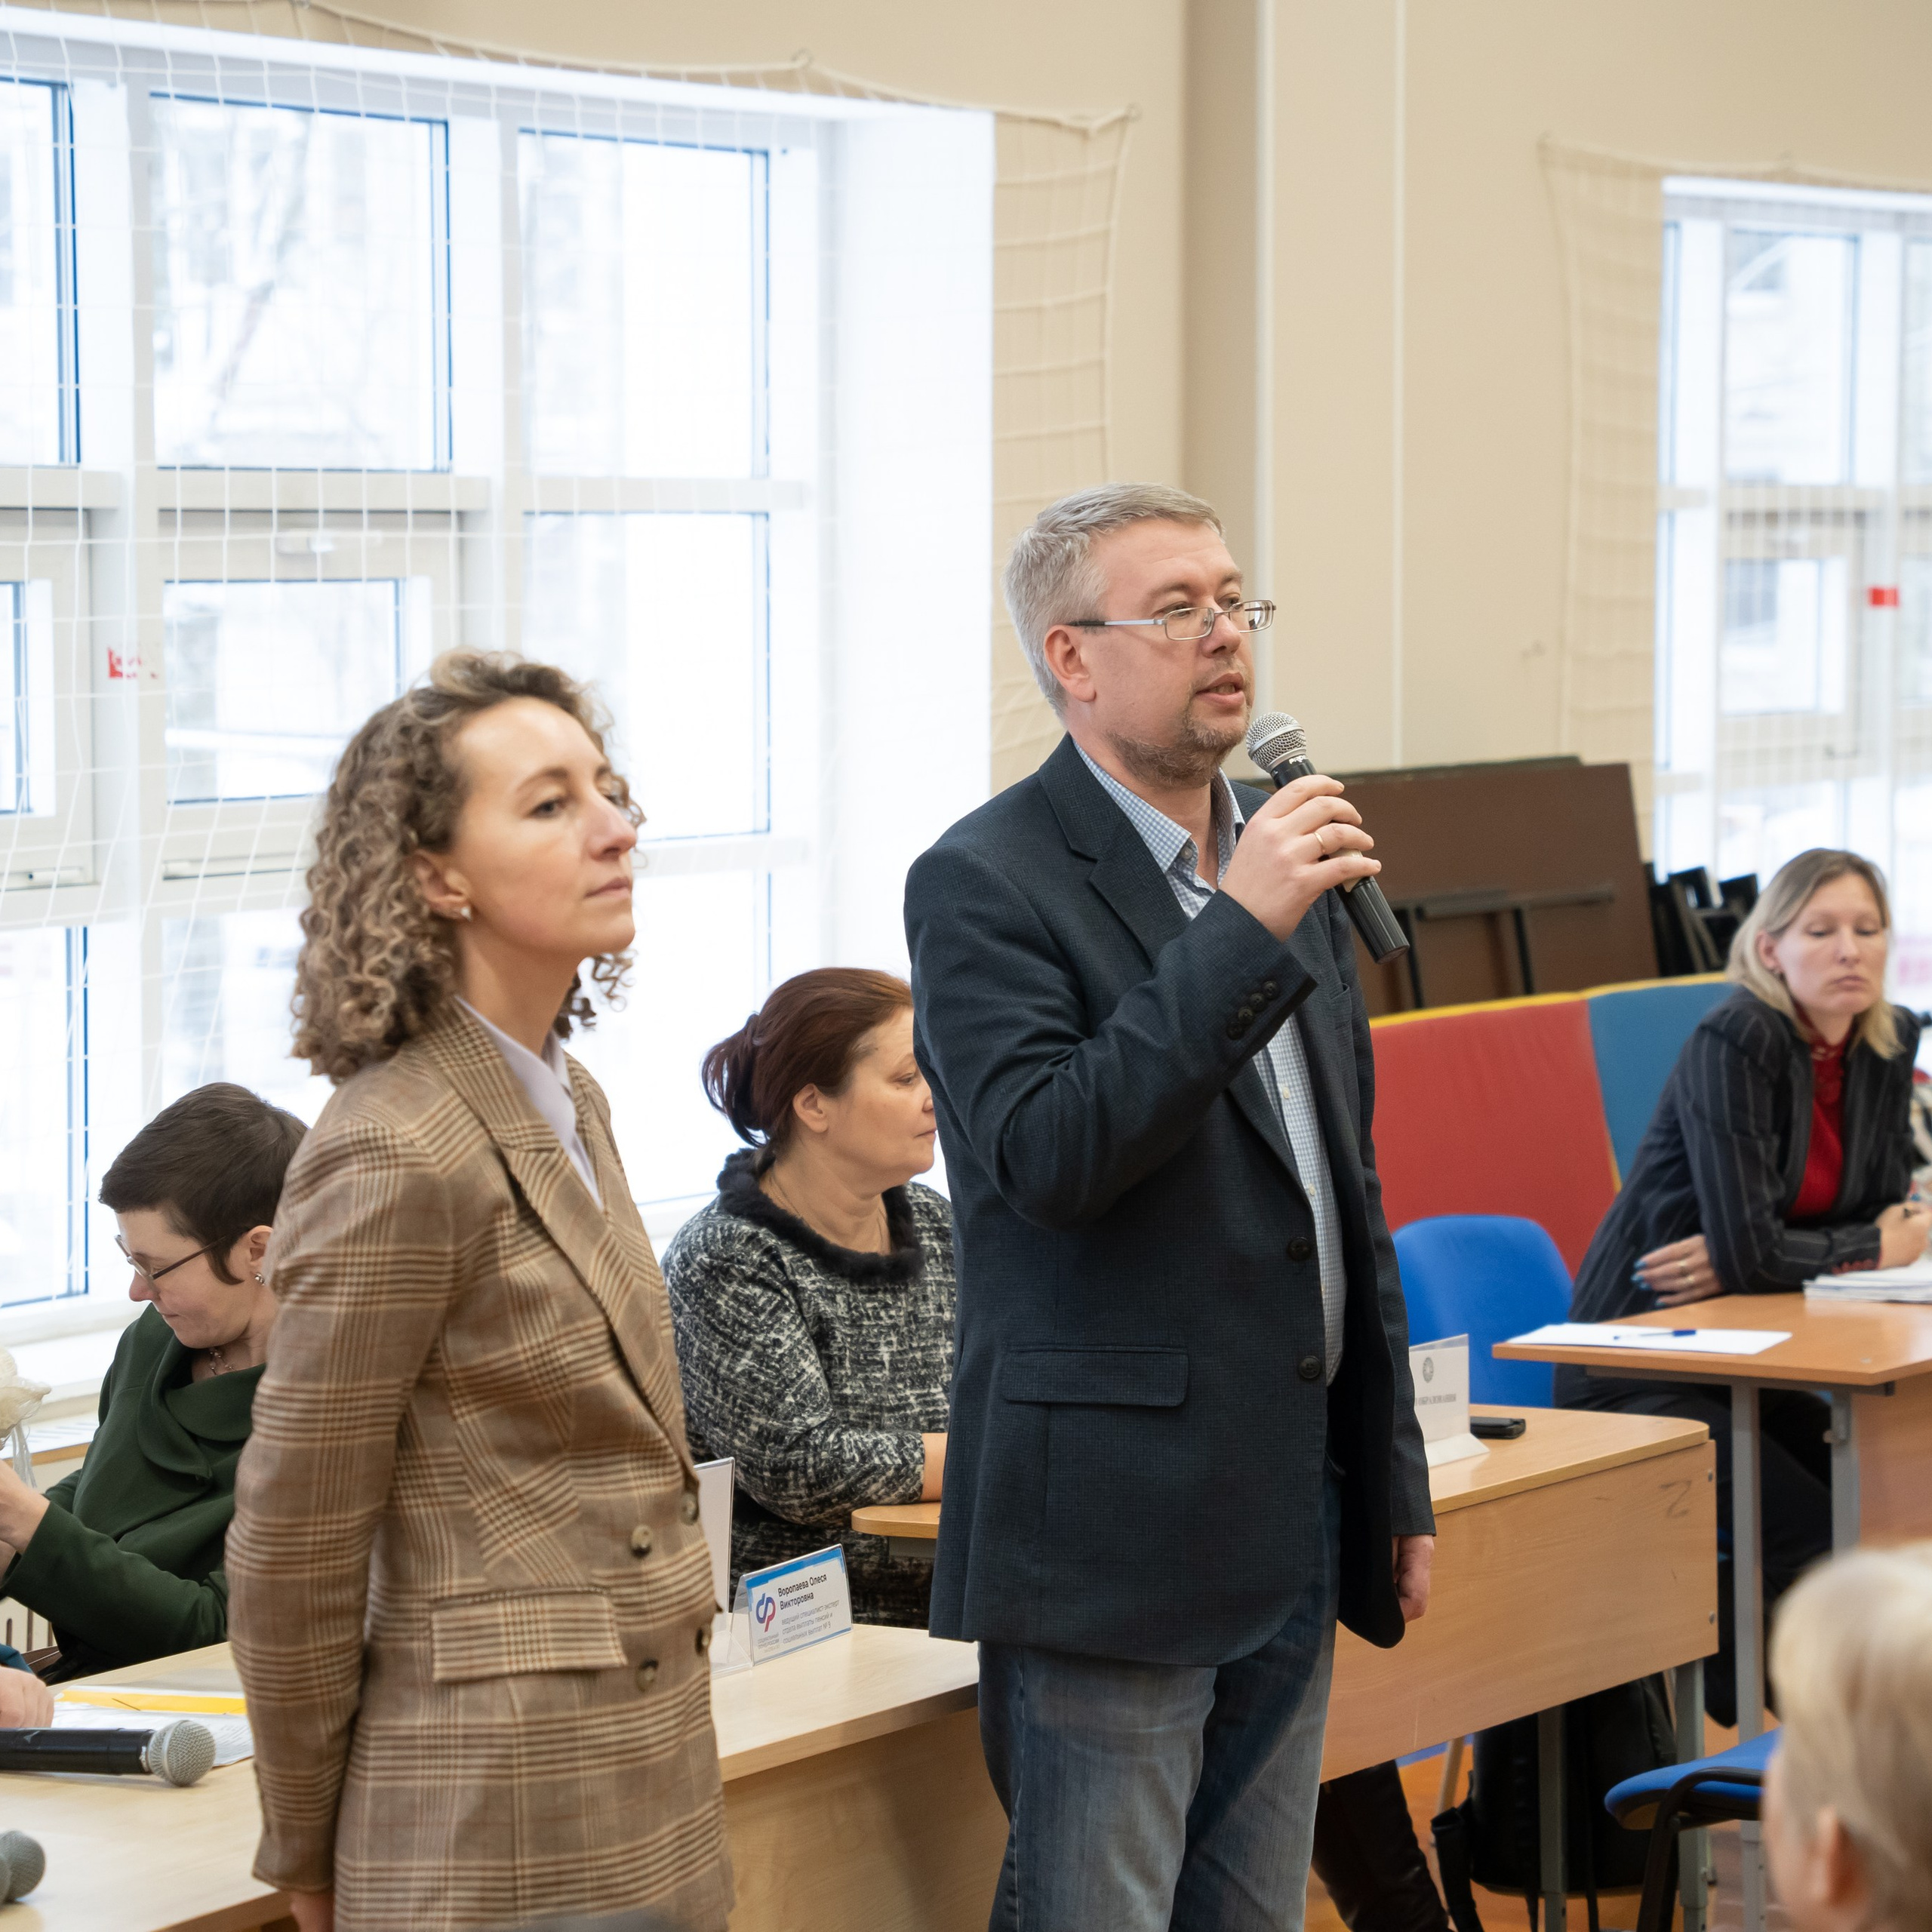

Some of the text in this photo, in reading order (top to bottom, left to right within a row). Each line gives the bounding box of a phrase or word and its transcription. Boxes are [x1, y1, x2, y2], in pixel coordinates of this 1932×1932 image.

[778, 1574, 828, 1597] Воропаева Олеся
[780, 1592, 814, 1610] Викторовна
